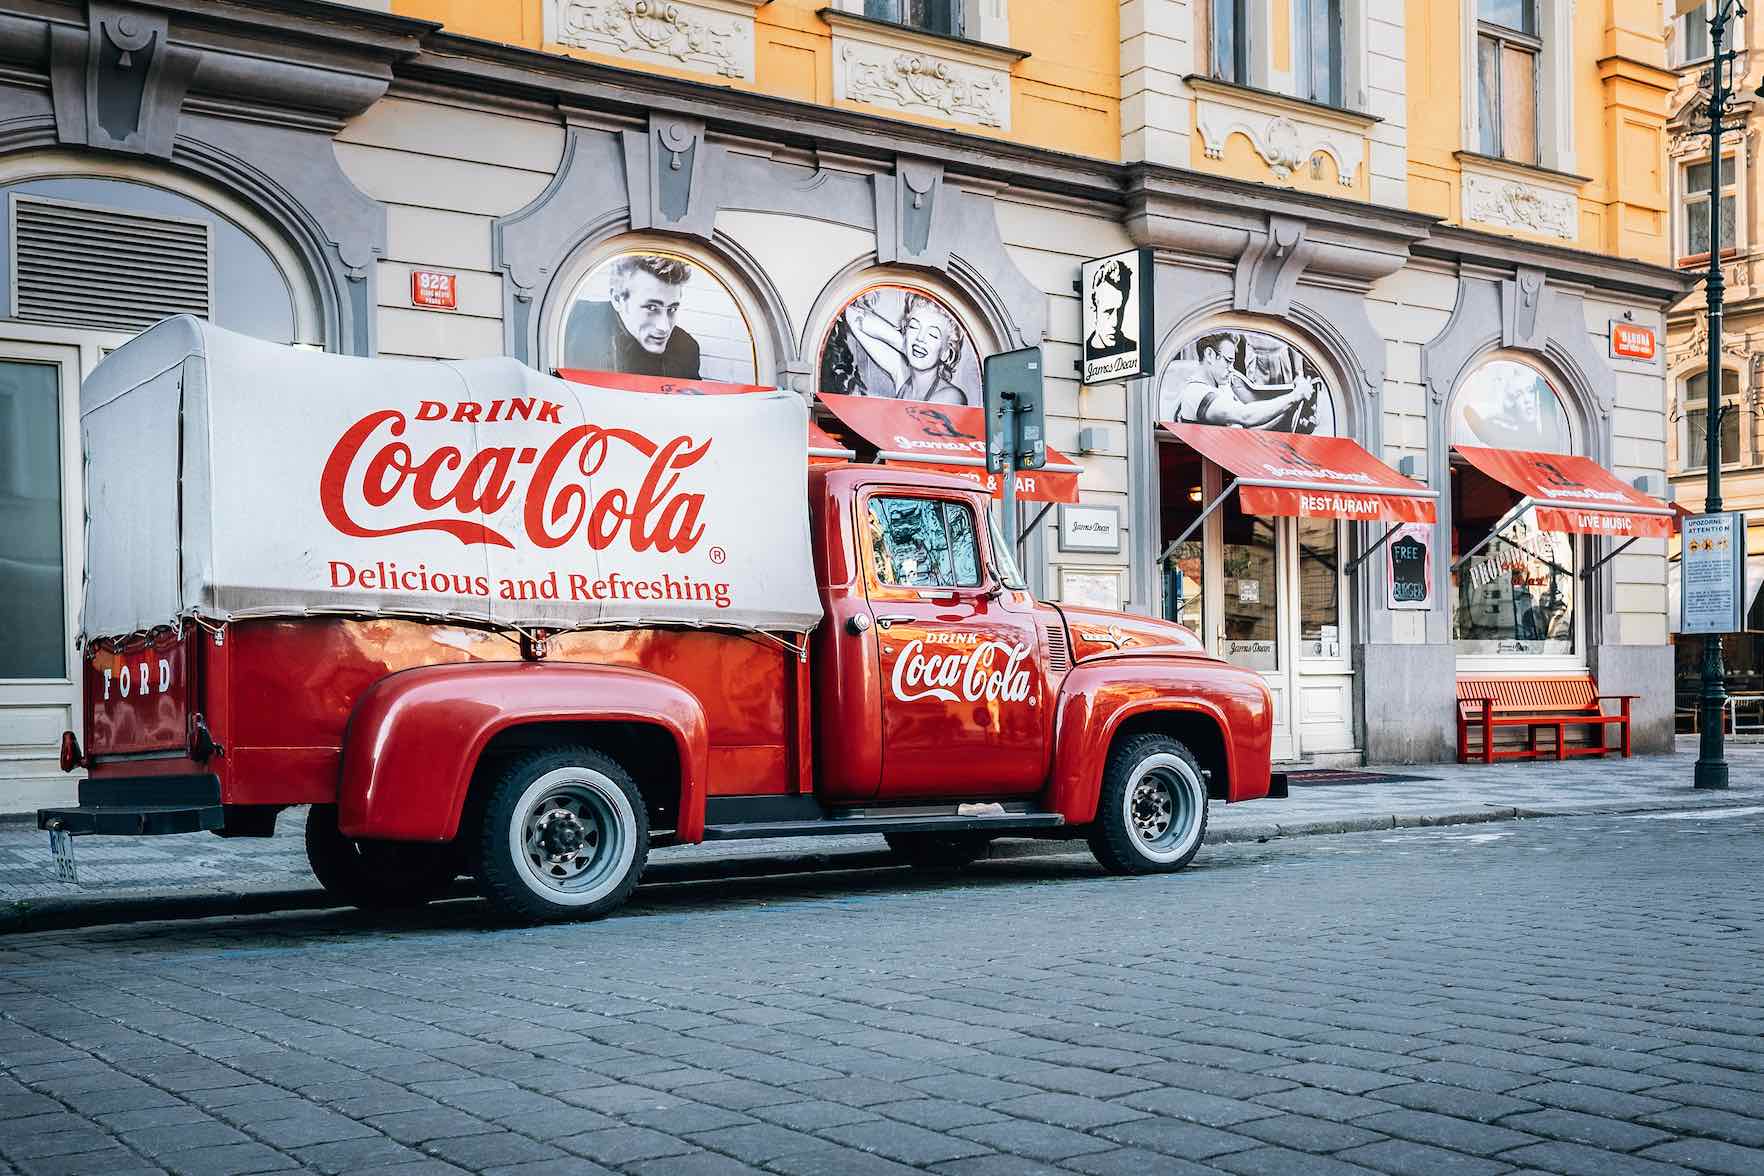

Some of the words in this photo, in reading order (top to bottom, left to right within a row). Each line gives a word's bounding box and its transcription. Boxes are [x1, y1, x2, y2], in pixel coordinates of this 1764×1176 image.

[421, 273, 448, 289] 922
[1085, 362, 1113, 381] James
[1114, 357, 1138, 372] Dean
[414, 397, 564, 424] DRINK
[319, 409, 713, 553] Coca-Cola
[986, 475, 997, 491] &
[1014, 477, 1035, 493] AR
[1301, 495, 1379, 513] RESTAURANT
[1578, 514, 1600, 528] LIVE
[1602, 517, 1632, 530] MUSIC
[1688, 526, 1730, 534] ATTENTION
[1394, 545, 1419, 560] FREE
[327, 561, 489, 596] Delicious
[499, 571, 559, 600] and
[568, 573, 731, 608] Refreshing
[1394, 582, 1424, 599] BURGER
[925, 632, 978, 644] DRINK
[104, 659, 170, 700] FORD
[891, 639, 1032, 703] Coca-Cola
